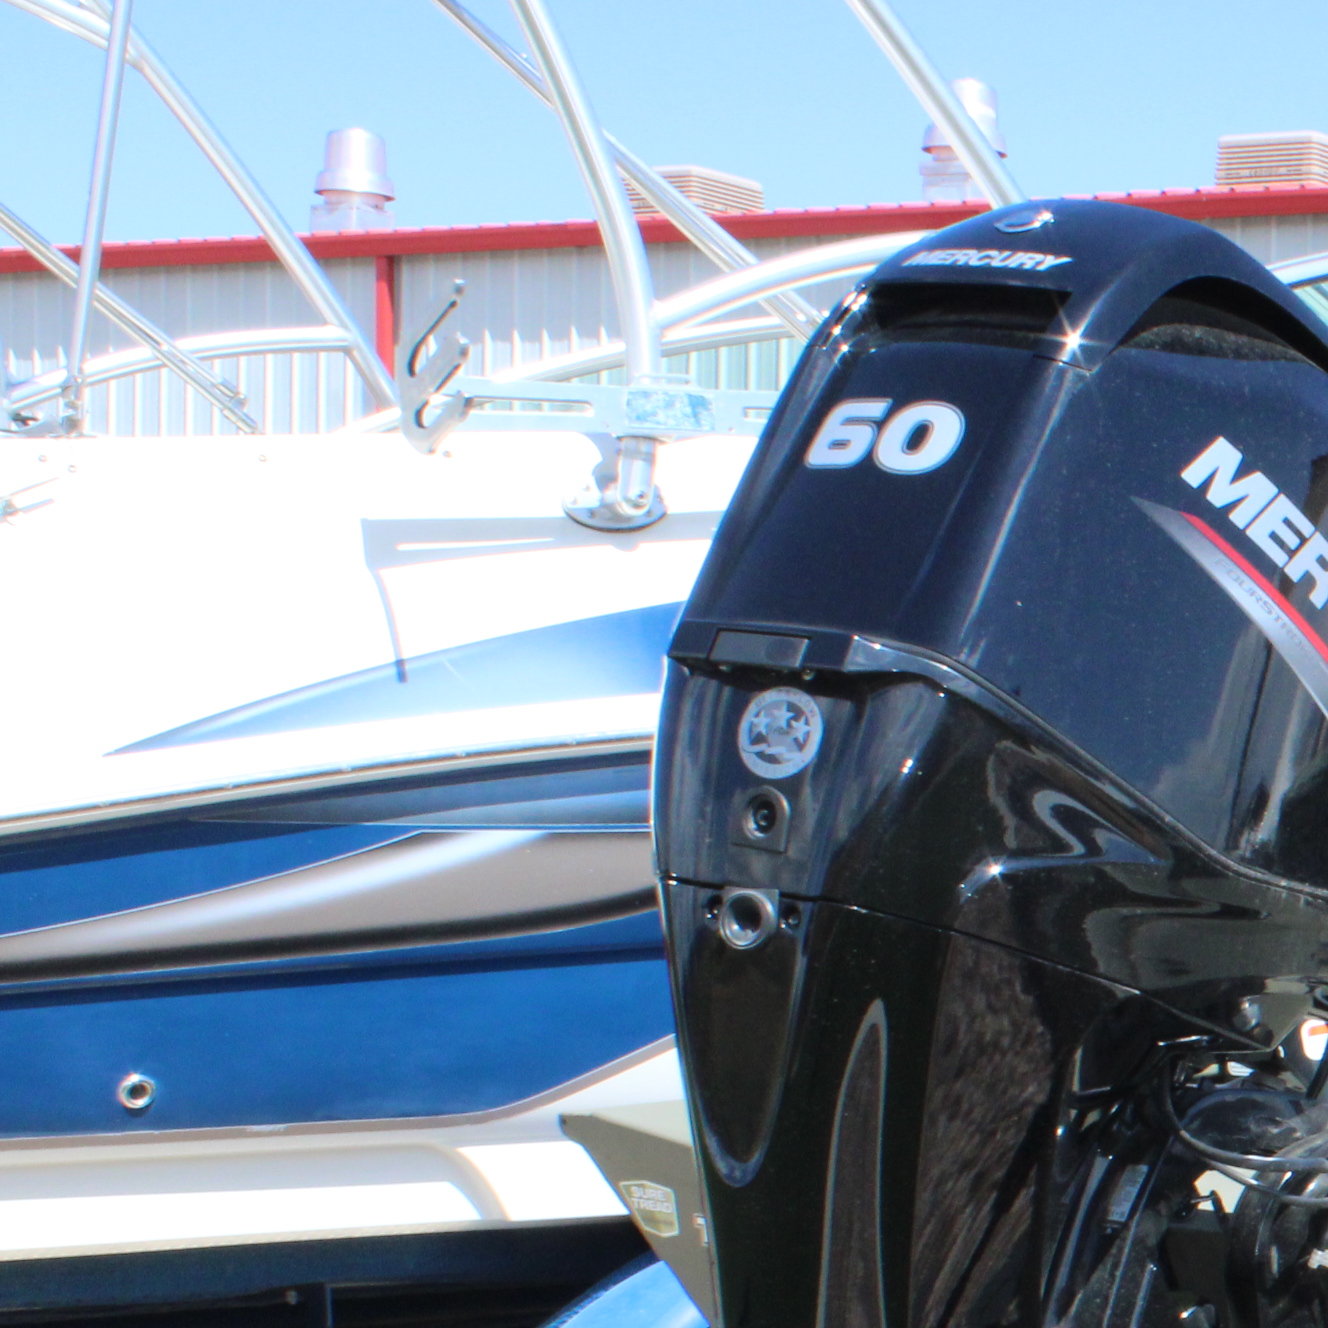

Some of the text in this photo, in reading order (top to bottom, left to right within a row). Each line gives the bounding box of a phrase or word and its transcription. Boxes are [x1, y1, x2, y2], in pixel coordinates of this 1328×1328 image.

[901, 248, 1073, 271] MERCURY
[804, 397, 966, 475] 60
[630, 1185, 667, 1201] SURE
[631, 1198, 674, 1213] TREAD
